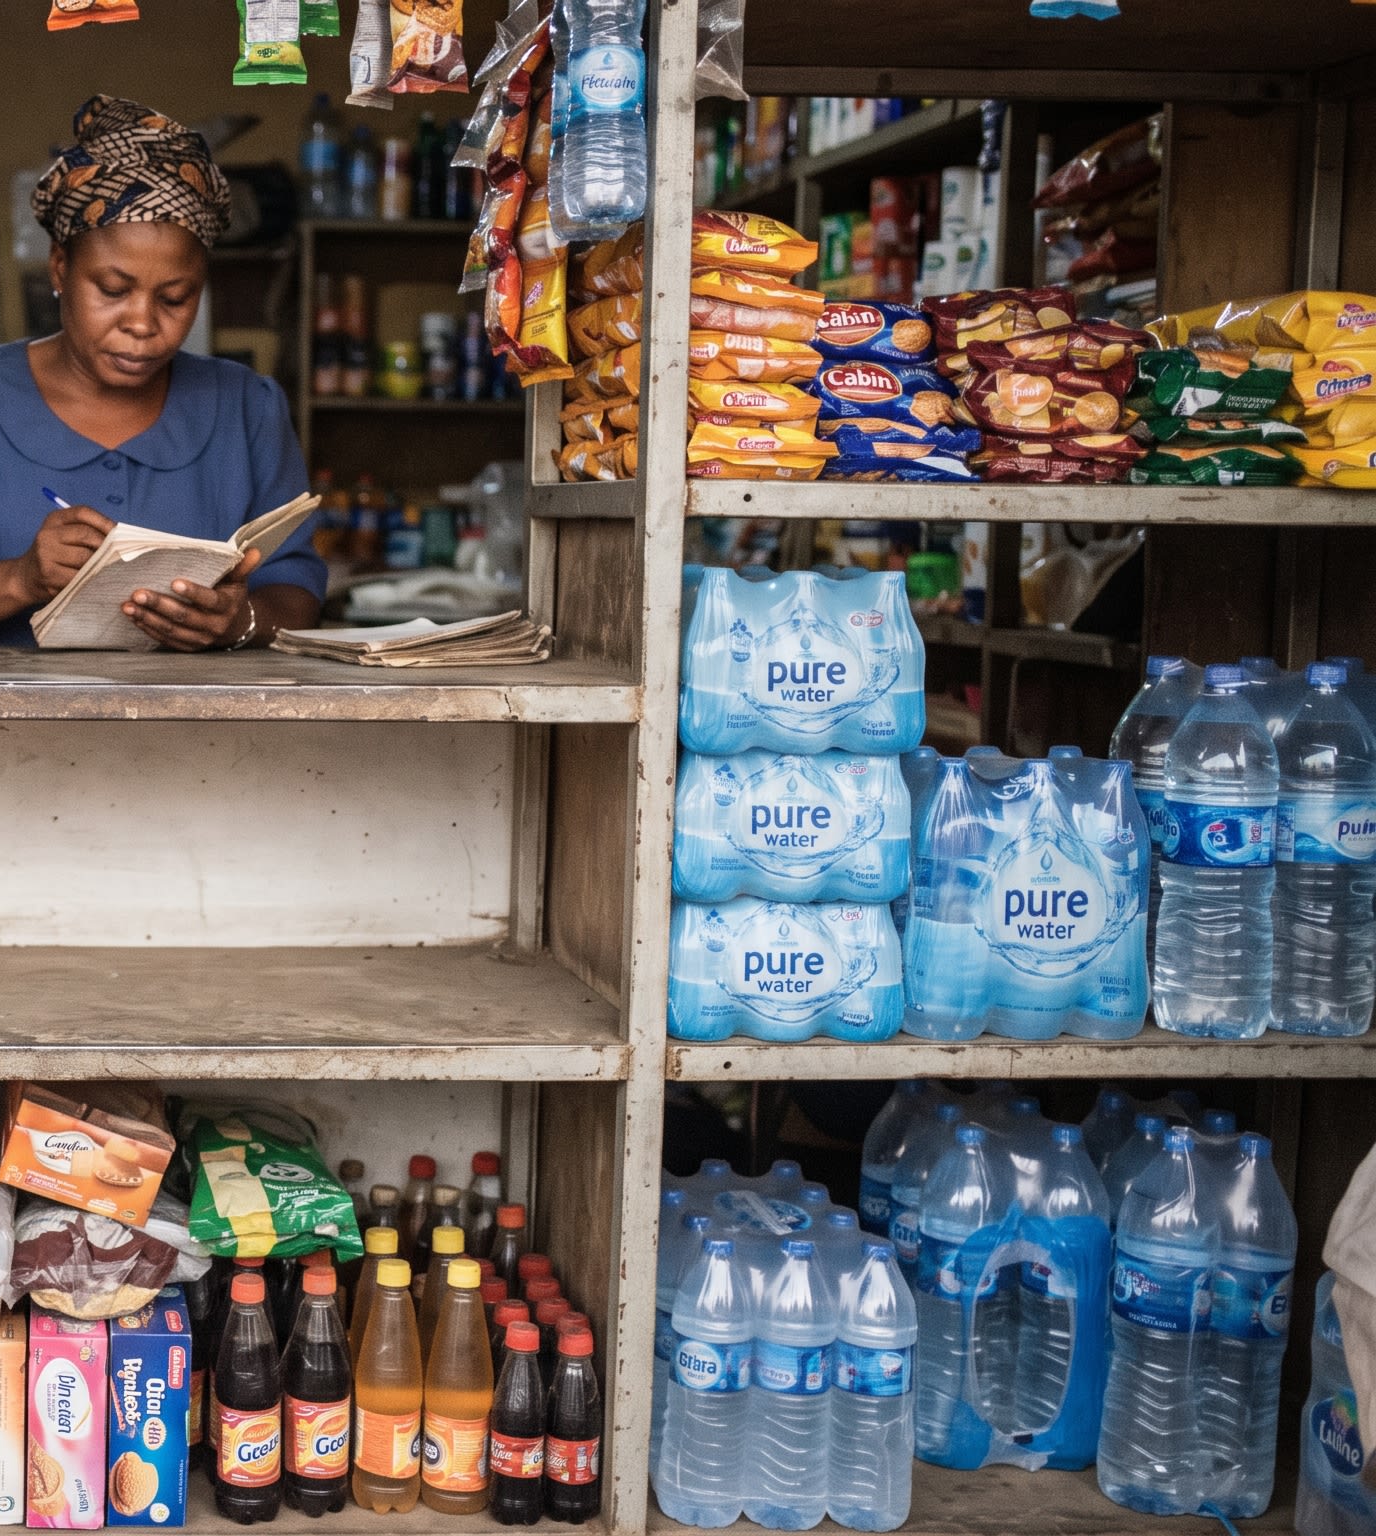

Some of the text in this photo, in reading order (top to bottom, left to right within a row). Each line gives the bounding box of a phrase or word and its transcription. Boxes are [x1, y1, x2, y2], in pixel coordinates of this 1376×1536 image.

[817, 310, 876, 329] Cabin
[827, 368, 893, 390] Cabin
[767, 660, 847, 692] pure
[780, 686, 835, 702] water
[751, 804, 831, 835] pure
[764, 831, 818, 848] water
[1003, 888, 1089, 926] pure
[1017, 921, 1076, 939] water
[744, 950, 825, 982] pure
[757, 977, 813, 993] water
